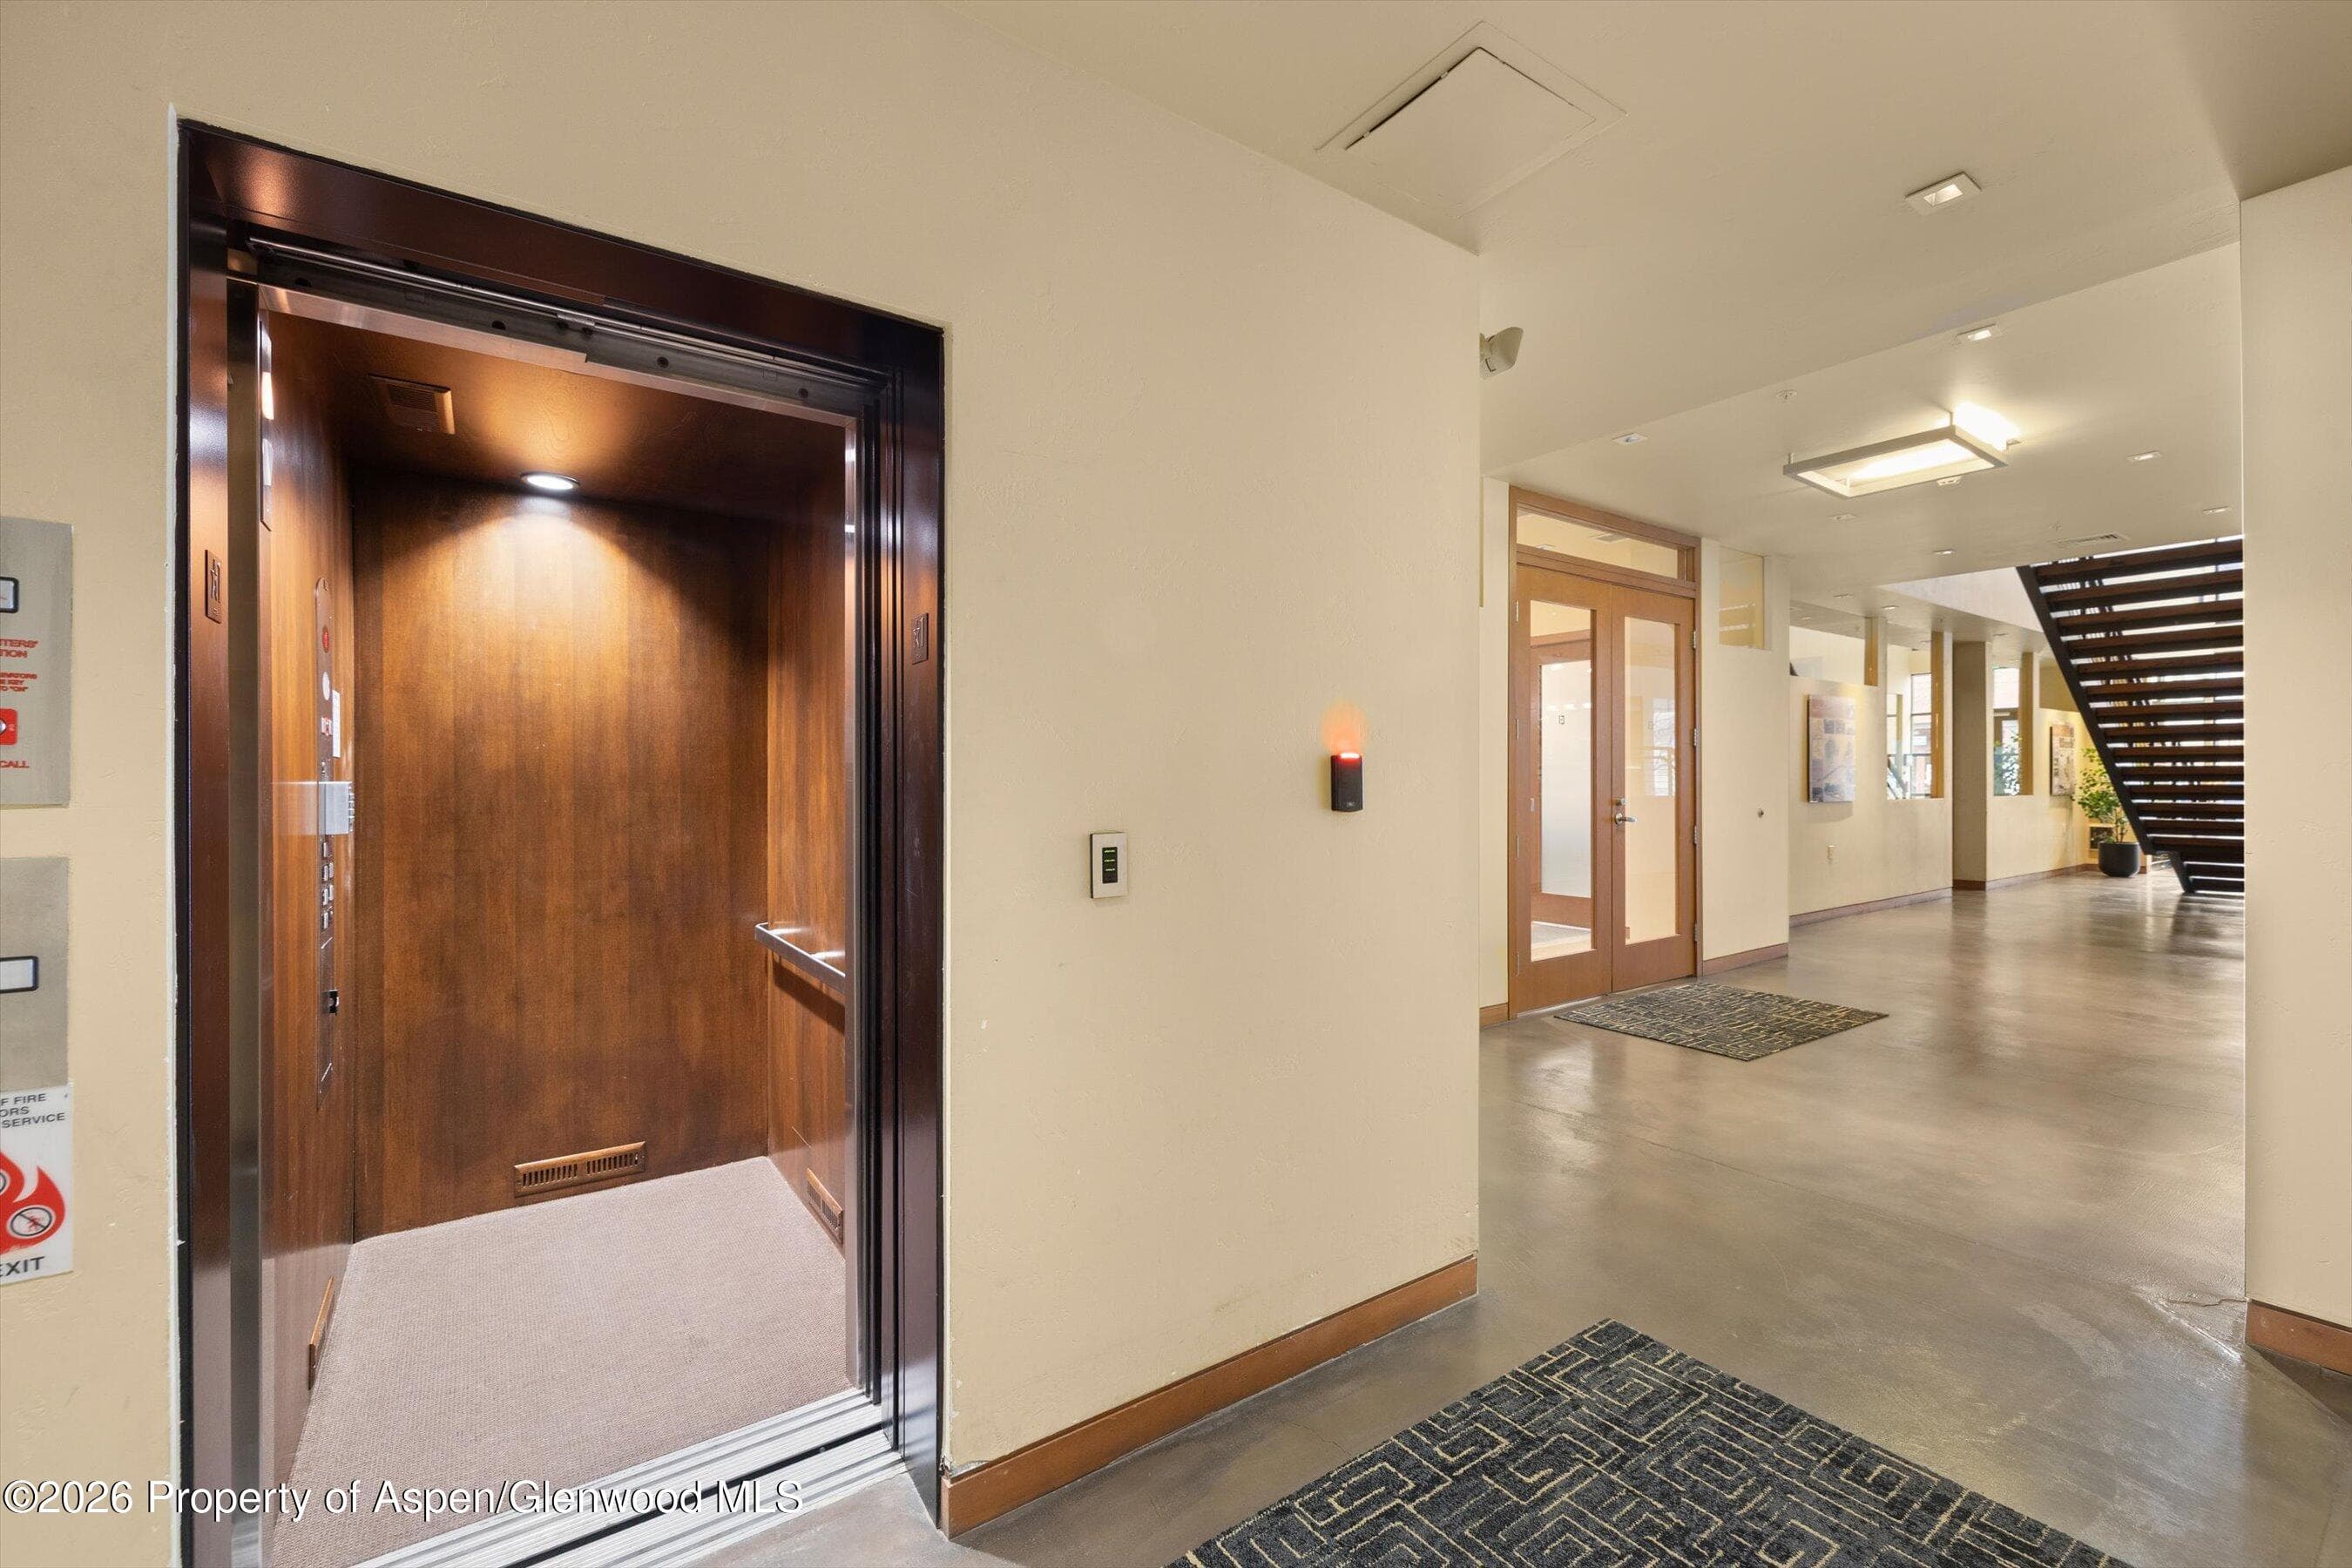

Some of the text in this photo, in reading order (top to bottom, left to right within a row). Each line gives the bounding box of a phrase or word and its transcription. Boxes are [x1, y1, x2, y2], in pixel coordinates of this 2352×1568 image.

[14, 1093, 46, 1105] FIRE
[0, 1106, 30, 1118] ORS
[2, 1112, 65, 1128] SERVICE
